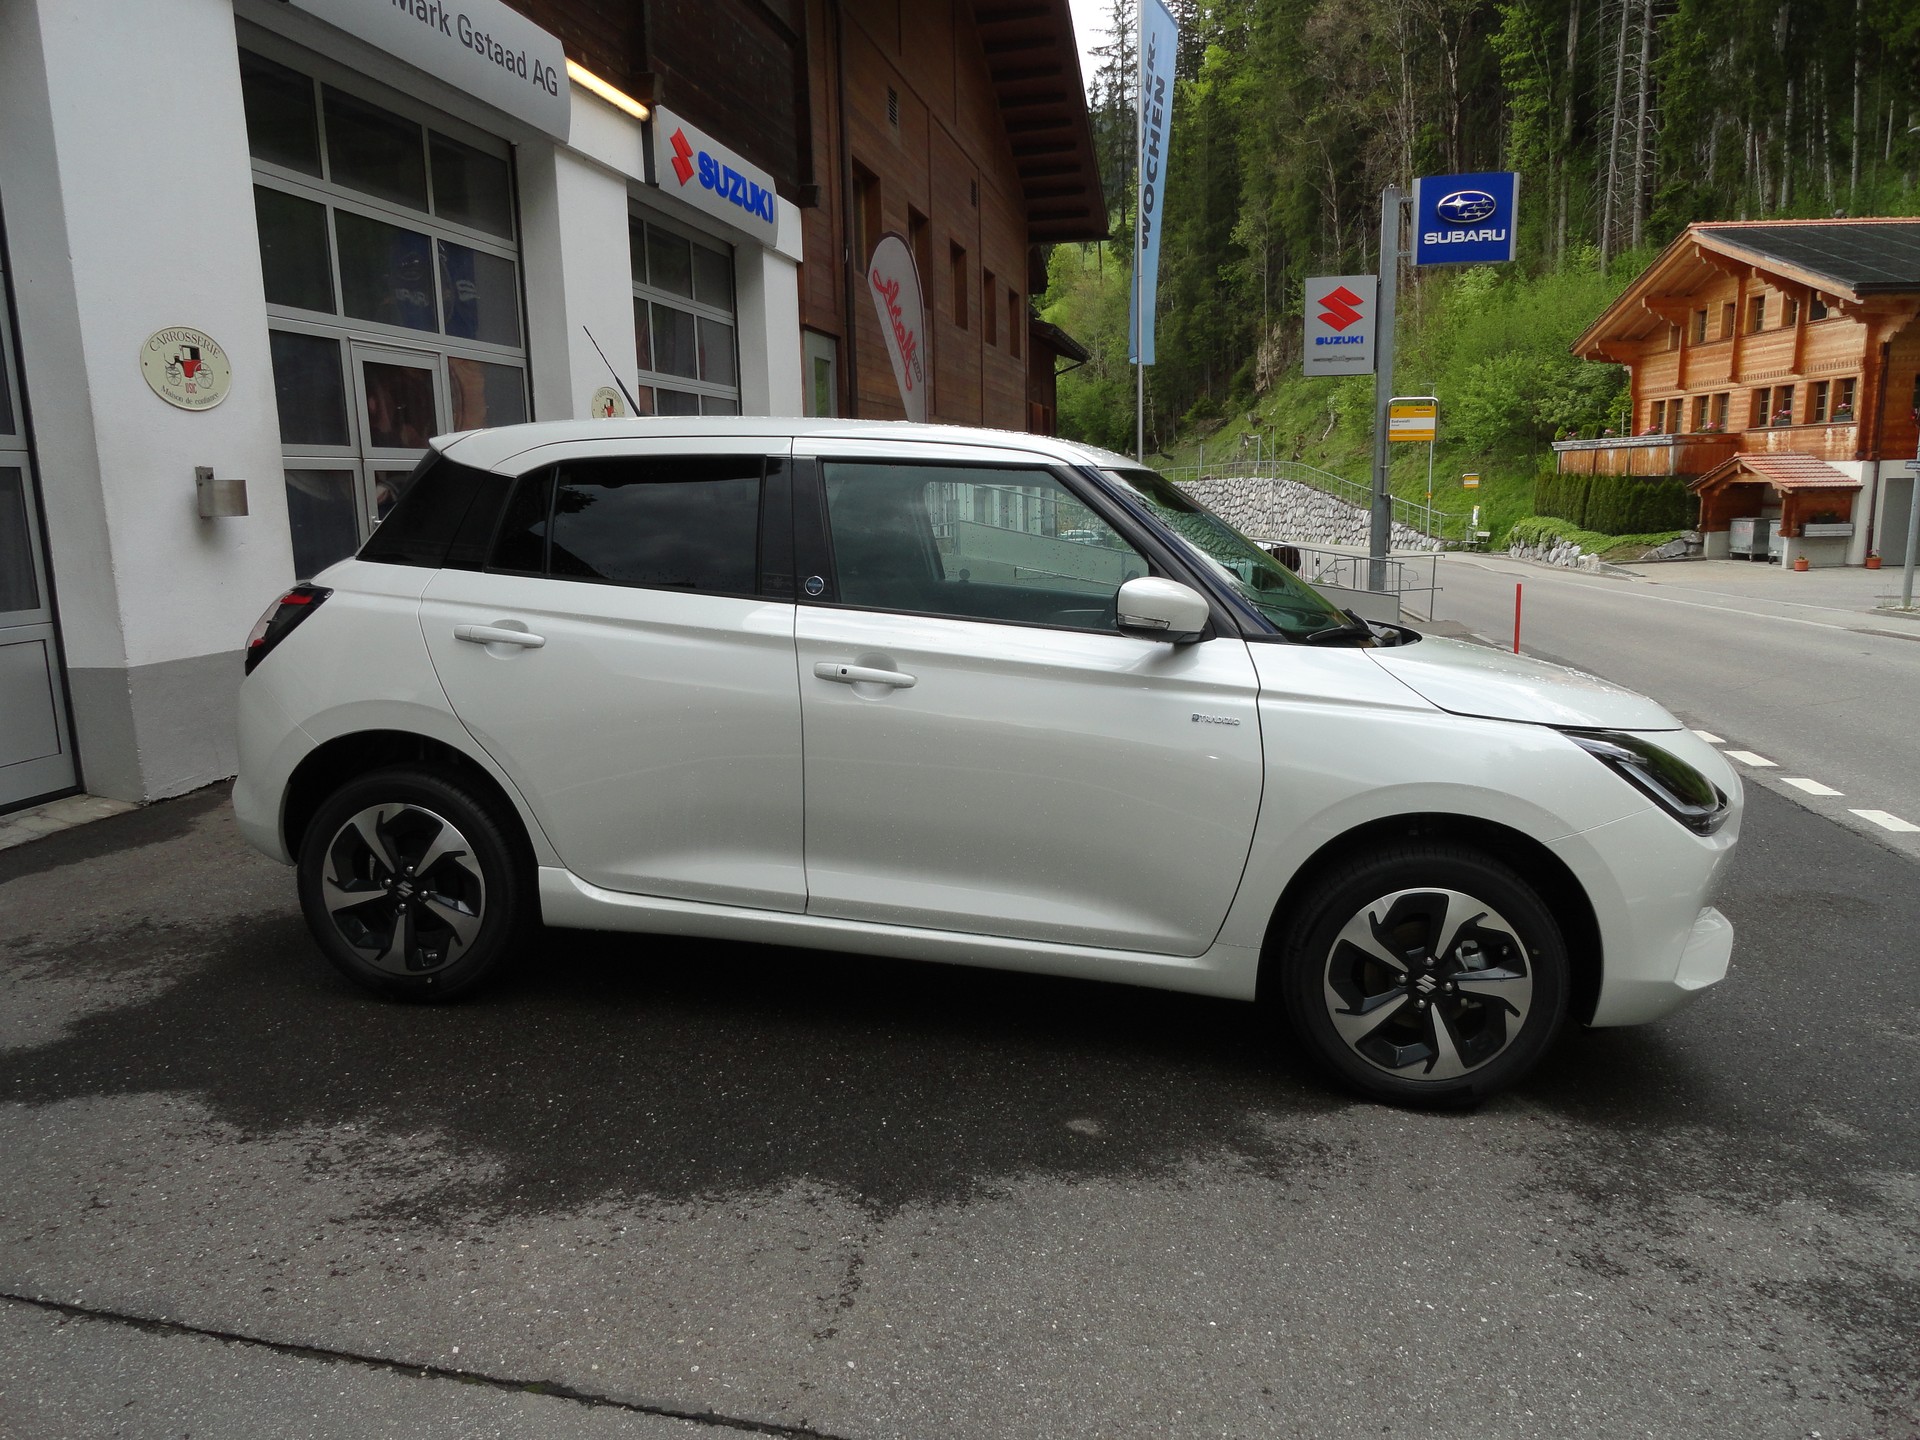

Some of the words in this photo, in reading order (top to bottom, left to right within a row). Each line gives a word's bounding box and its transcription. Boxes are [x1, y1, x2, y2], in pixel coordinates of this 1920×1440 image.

[457, 14, 527, 80] Gstaad
[533, 59, 558, 97] AG
[1142, 74, 1166, 250] WOCHEN
[698, 151, 773, 224] SUZUKI
[1424, 229, 1506, 245] SUBARU
[149, 330, 221, 359] CARROSSERIE
[1315, 335, 1364, 346] SUZUKI
[161, 385, 184, 402] Maison
[186, 397, 193, 405] de
[195, 392, 219, 405] confiance
